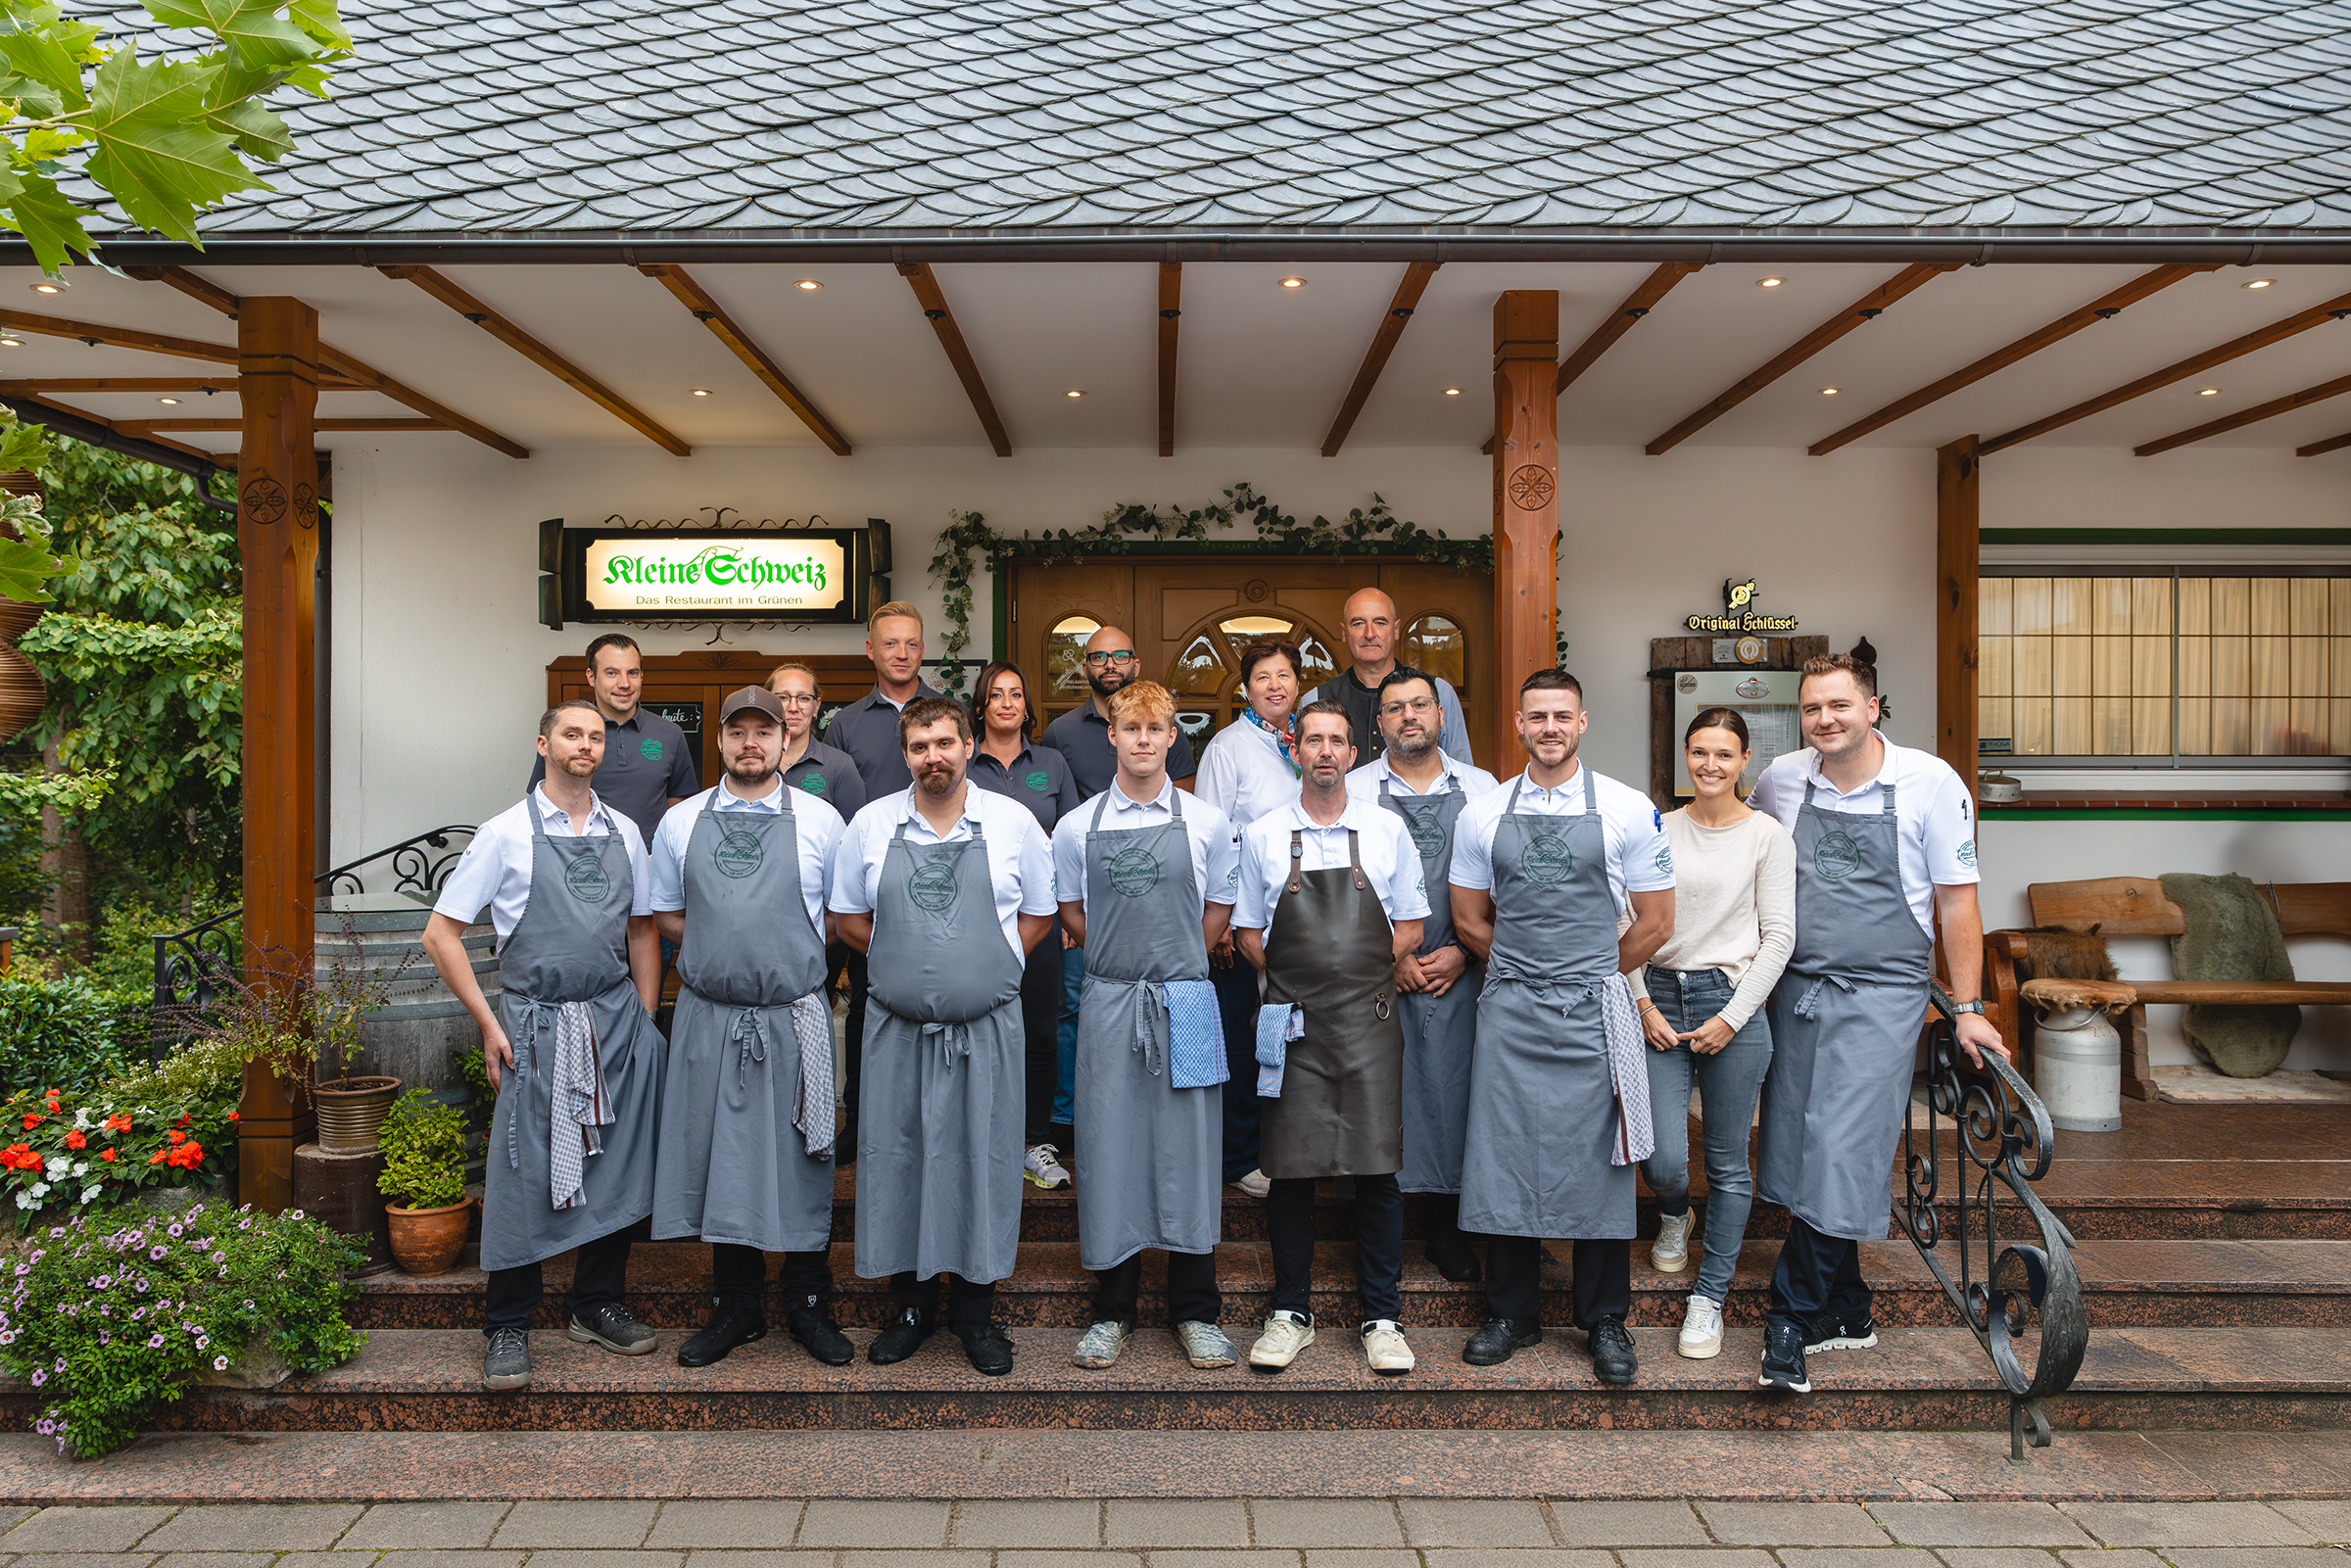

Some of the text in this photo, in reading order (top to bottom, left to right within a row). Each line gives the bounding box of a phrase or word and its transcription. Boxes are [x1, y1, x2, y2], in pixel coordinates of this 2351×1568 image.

[602, 546, 827, 591] Kleine Schweiz
[636, 594, 802, 604] Das Restaurant im Grünen
[1689, 611, 1796, 632] Original Schlüssel
